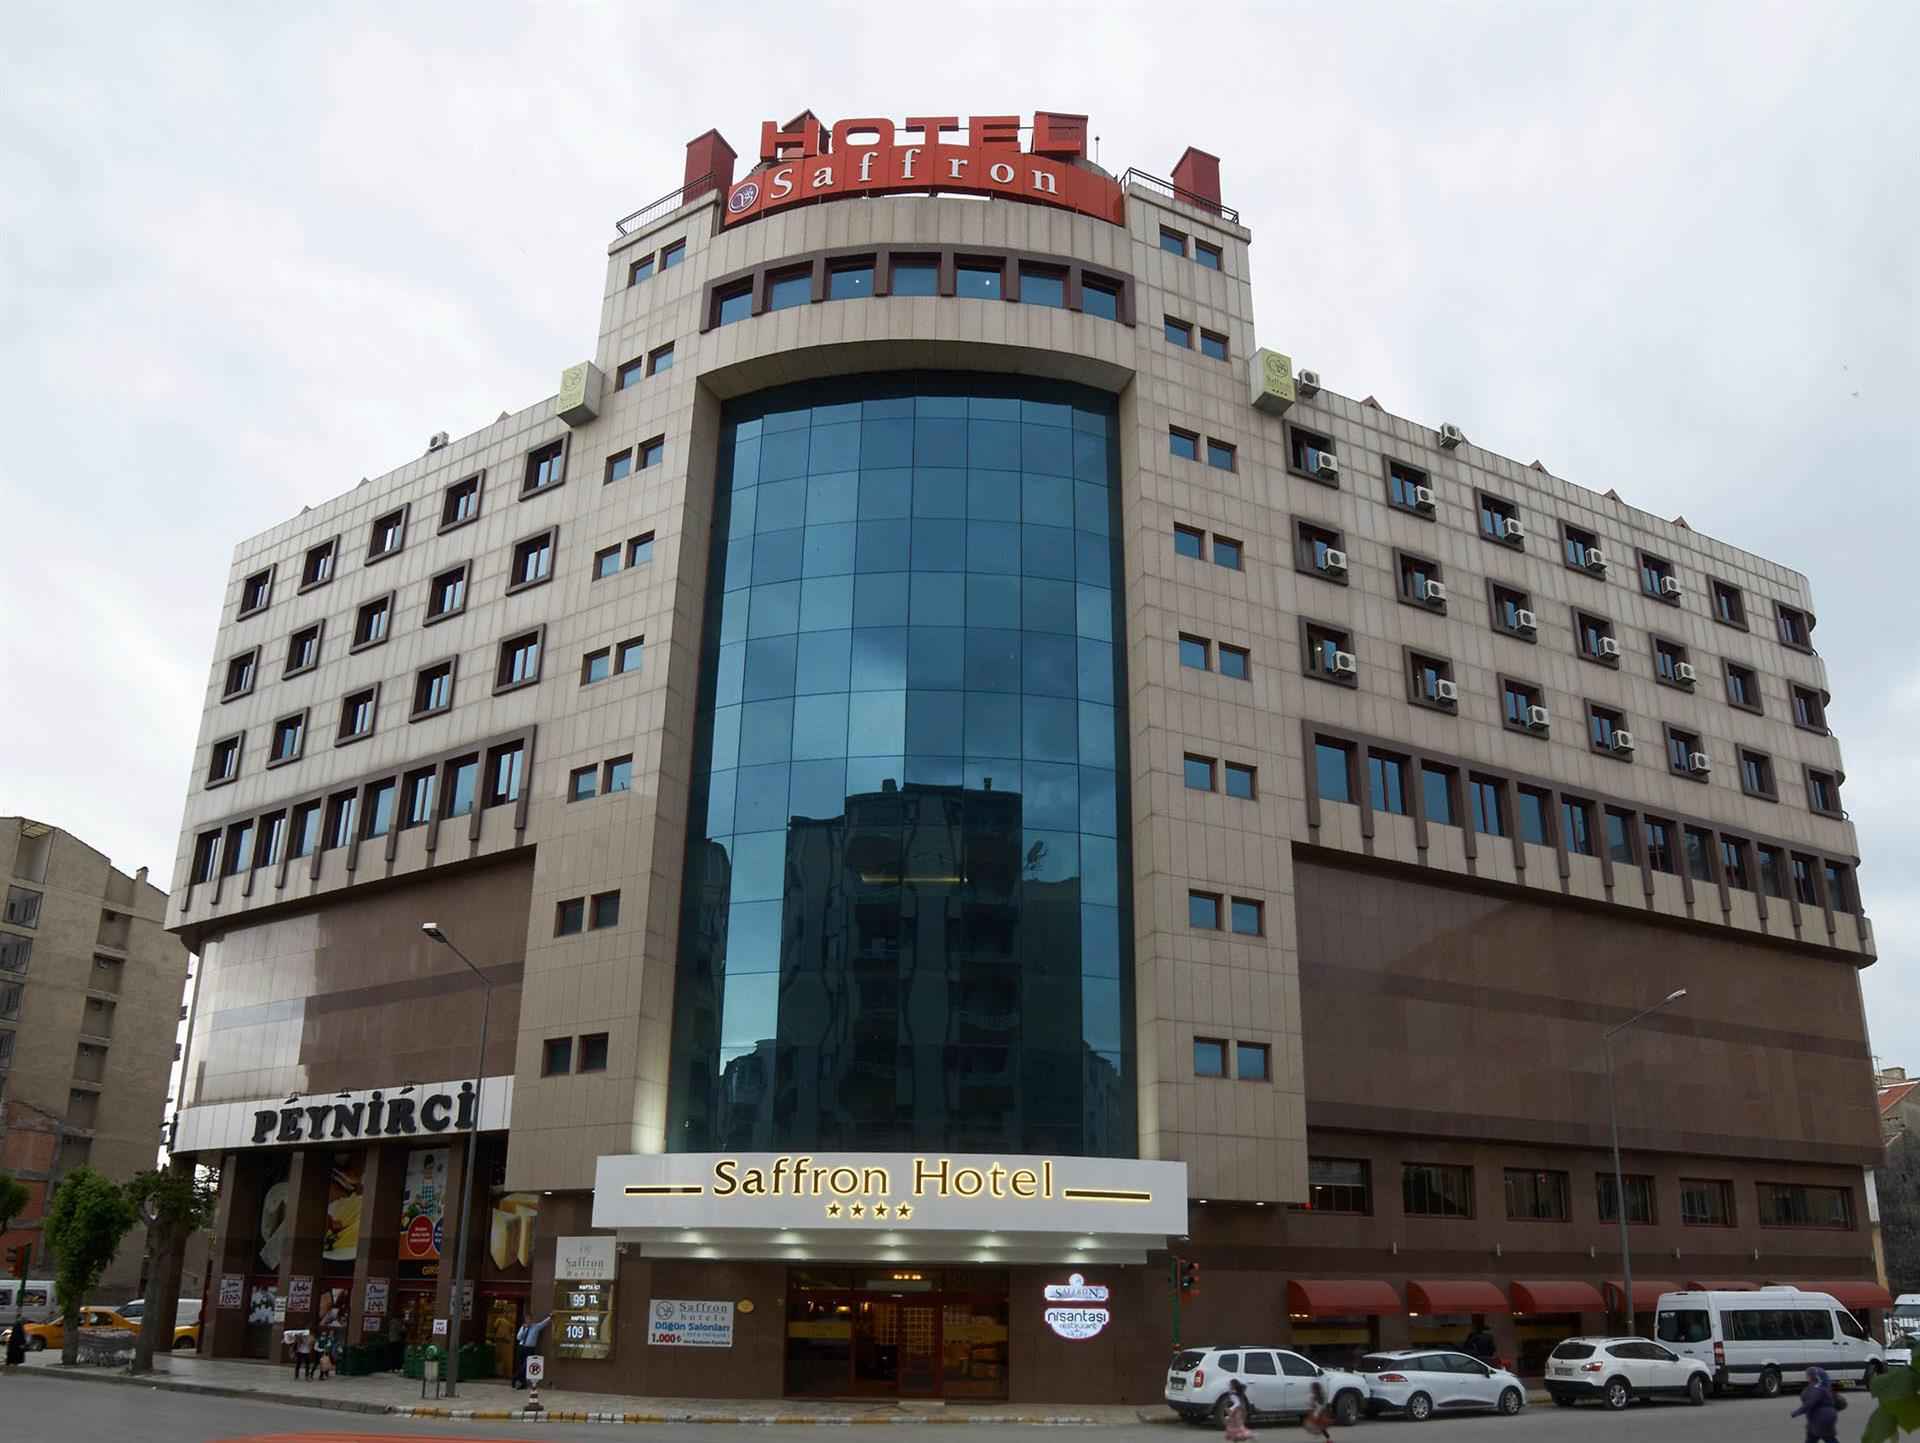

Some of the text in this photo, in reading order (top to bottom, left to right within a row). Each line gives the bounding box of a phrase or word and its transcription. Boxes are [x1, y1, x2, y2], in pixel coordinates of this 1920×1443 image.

[761, 111, 1083, 158] HOTEL
[770, 148, 1058, 200] Saffron
[252, 1082, 476, 1144] PEYNİRCİ
[713, 1157, 1053, 1197] Saffron Hotel
[573, 1294, 598, 1306] 99 TL
[680, 1303, 728, 1313] Saffron
[566, 1325, 597, 1338] 109 TL
